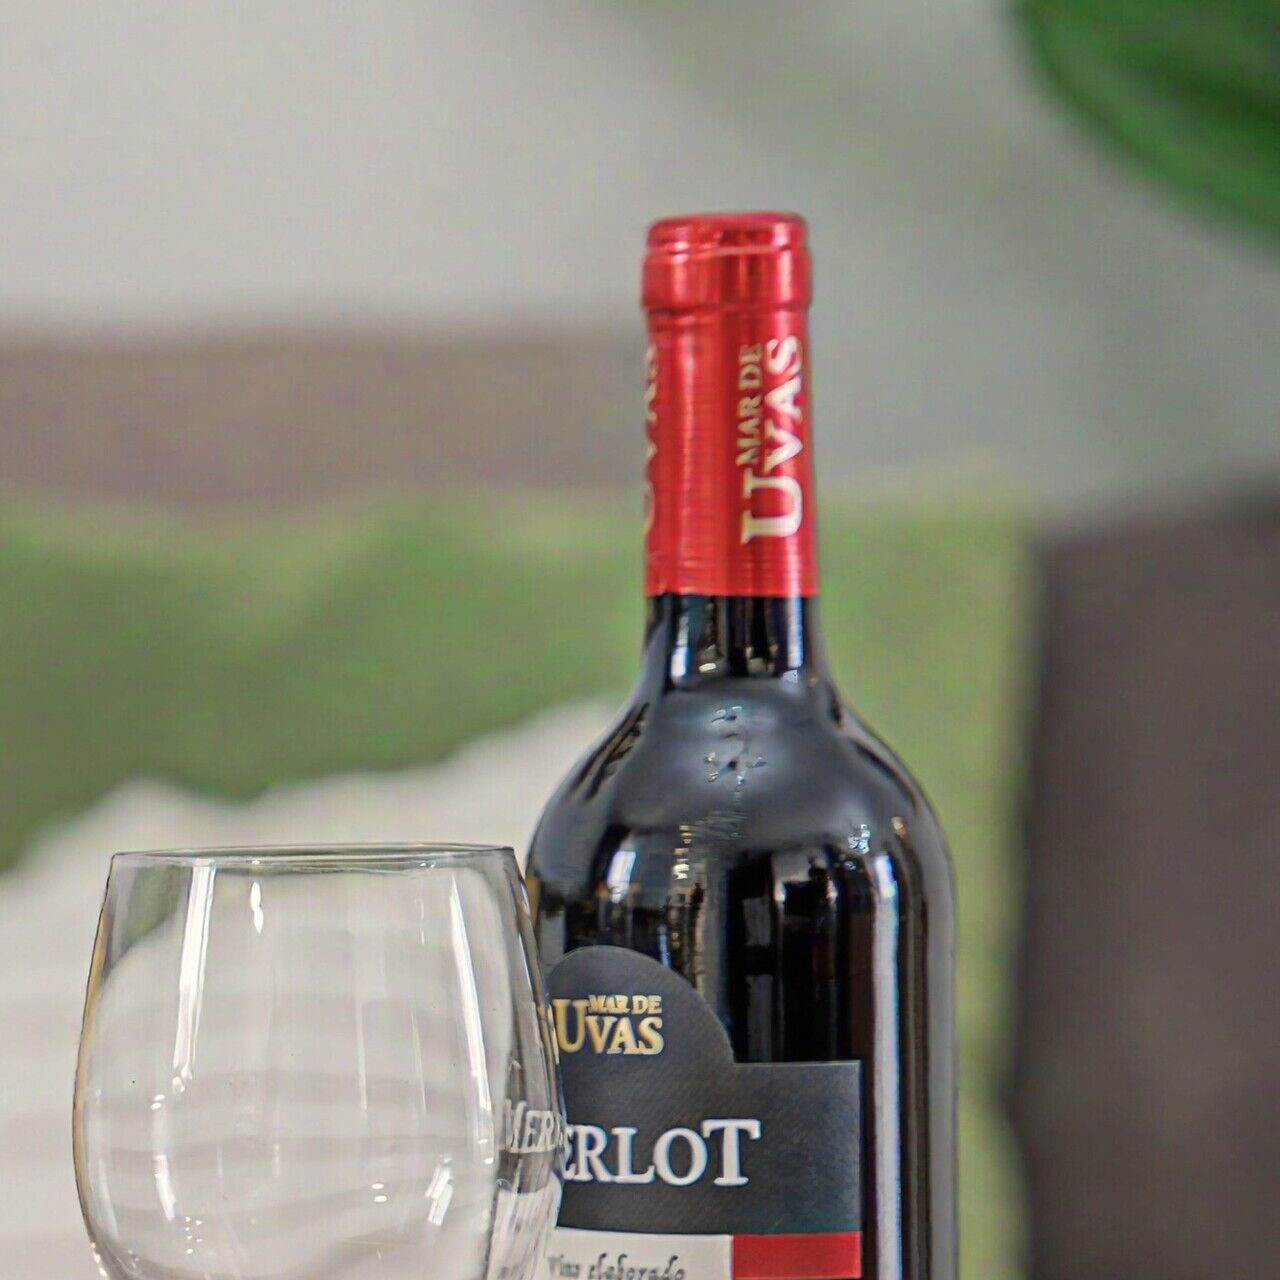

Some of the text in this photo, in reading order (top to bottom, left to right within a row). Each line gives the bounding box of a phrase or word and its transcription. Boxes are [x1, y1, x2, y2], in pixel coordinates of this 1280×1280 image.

[736, 342, 764, 467] MAR DE
[741, 335, 804, 545] UVAS
[552, 998, 665, 1055] UVAS
[588, 994, 663, 1015] MAR DE
